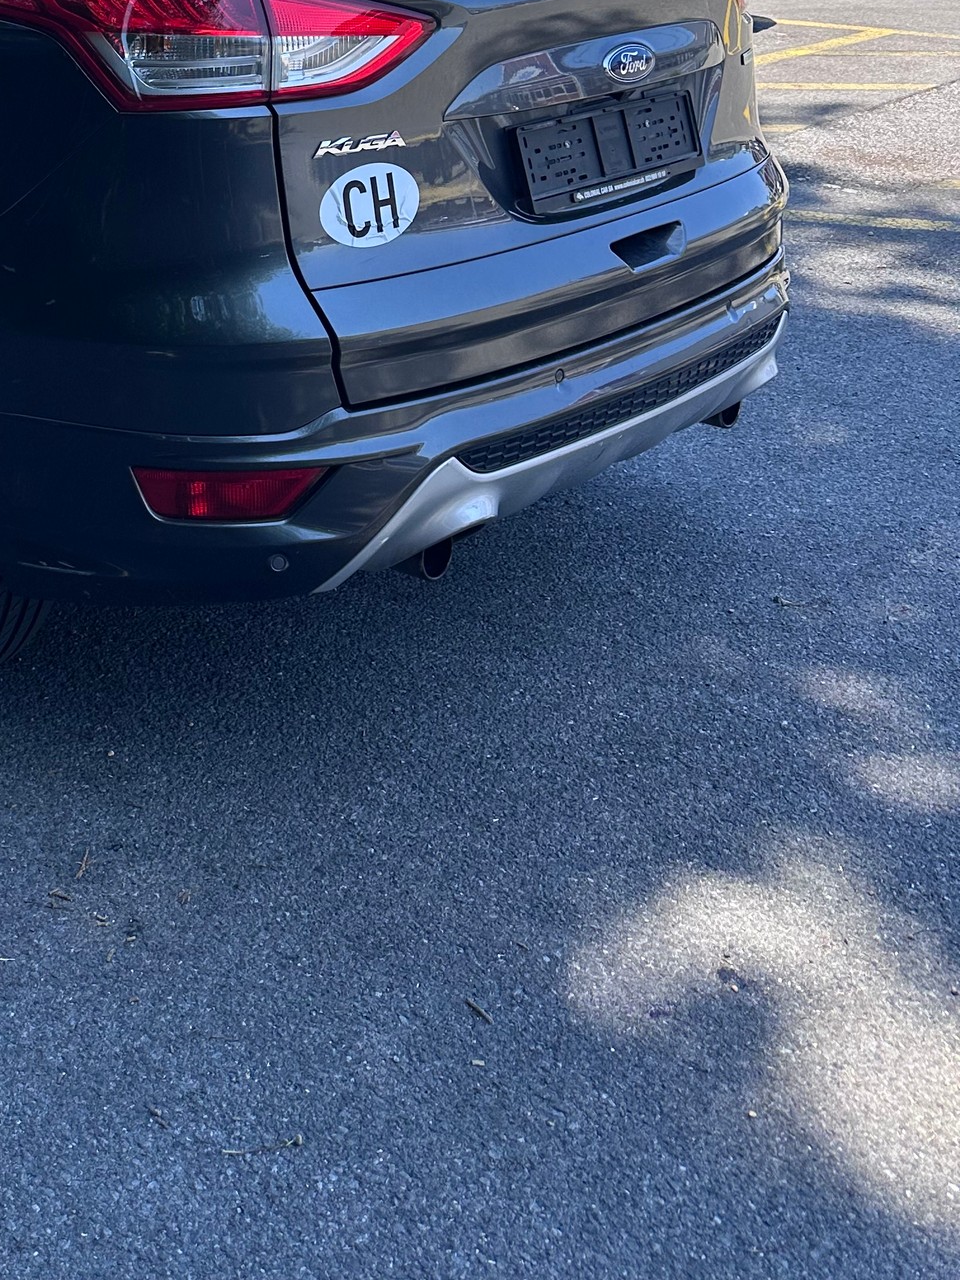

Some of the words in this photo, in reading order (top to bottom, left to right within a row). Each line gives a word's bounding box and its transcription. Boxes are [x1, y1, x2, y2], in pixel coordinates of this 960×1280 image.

[620, 51, 648, 75] Ford
[312, 130, 406, 159] KUGA
[342, 172, 400, 238] CH
